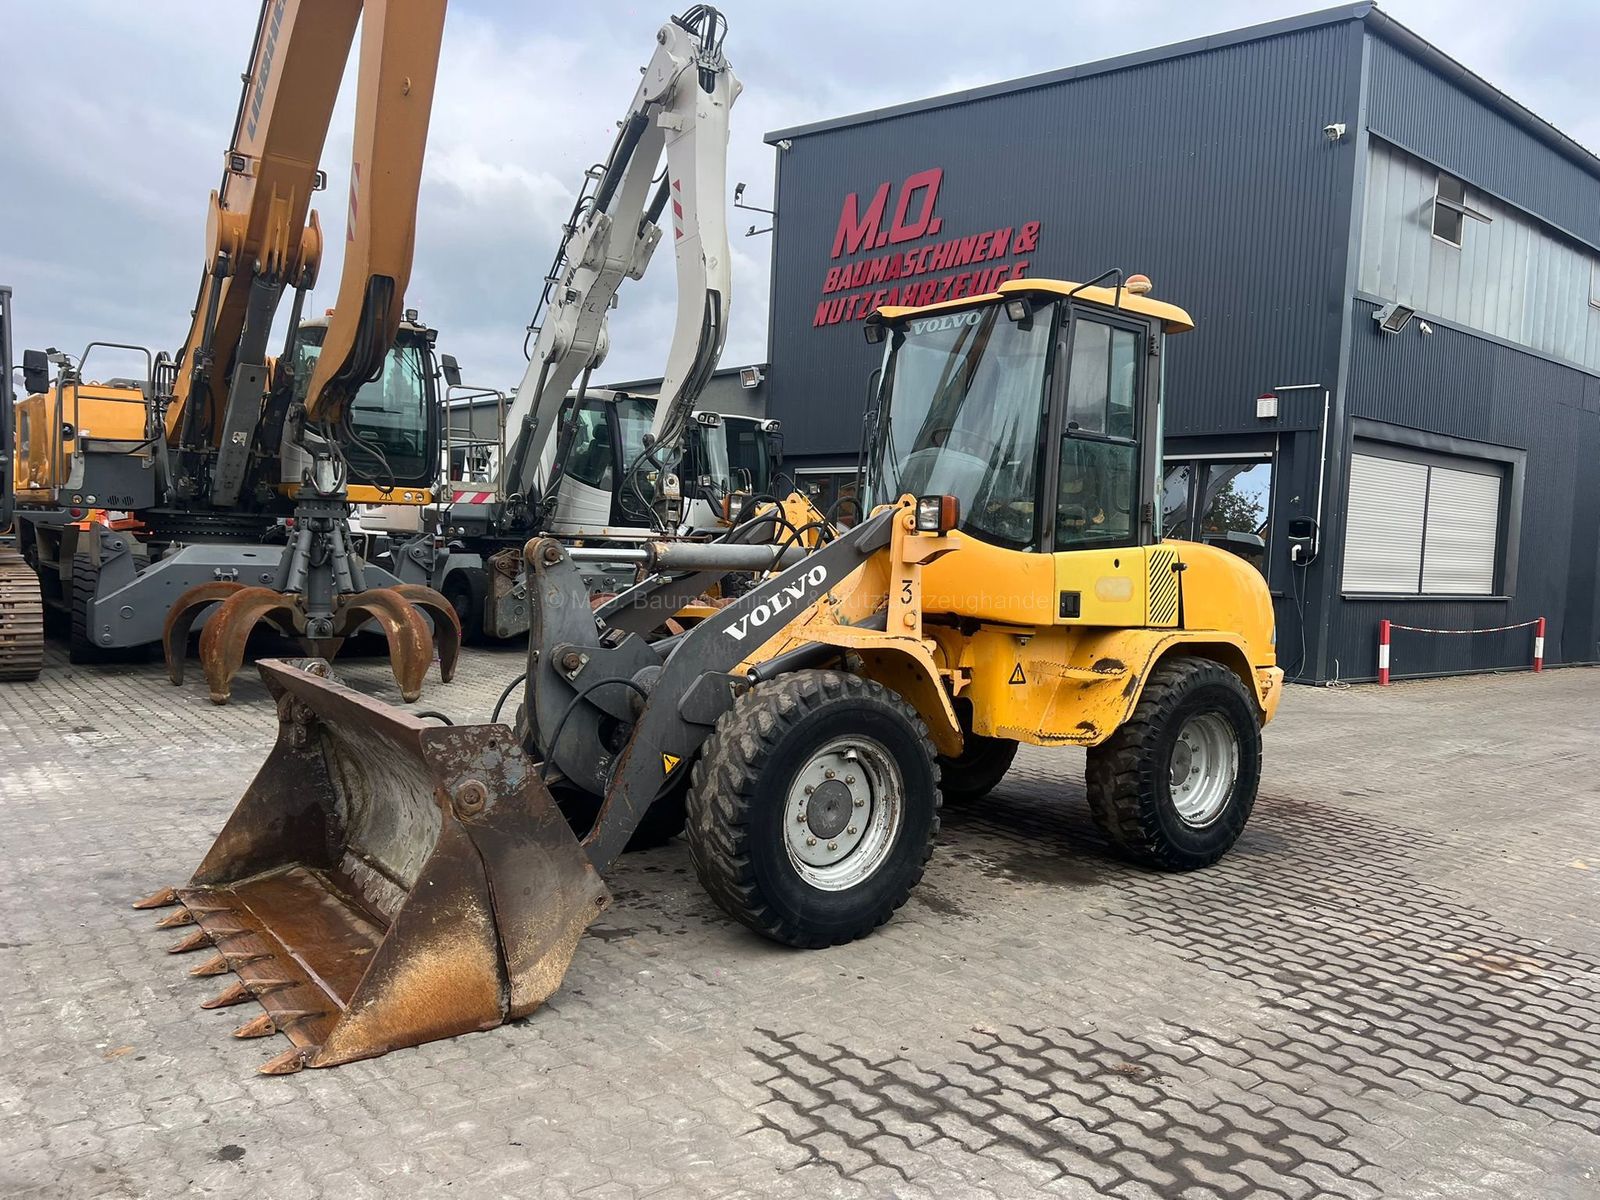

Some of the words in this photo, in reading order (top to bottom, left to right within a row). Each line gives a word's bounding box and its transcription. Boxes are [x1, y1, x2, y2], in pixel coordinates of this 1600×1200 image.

[831, 167, 943, 258] M.O.
[822, 227, 1012, 293] BAUMASCHINEN
[1014, 220, 1040, 254] &
[812, 260, 1029, 327] NUTZFAHRZEUGE
[912, 312, 981, 335] VOLVO
[722, 565, 827, 641] VOLVO
[901, 580, 912, 604] 3
